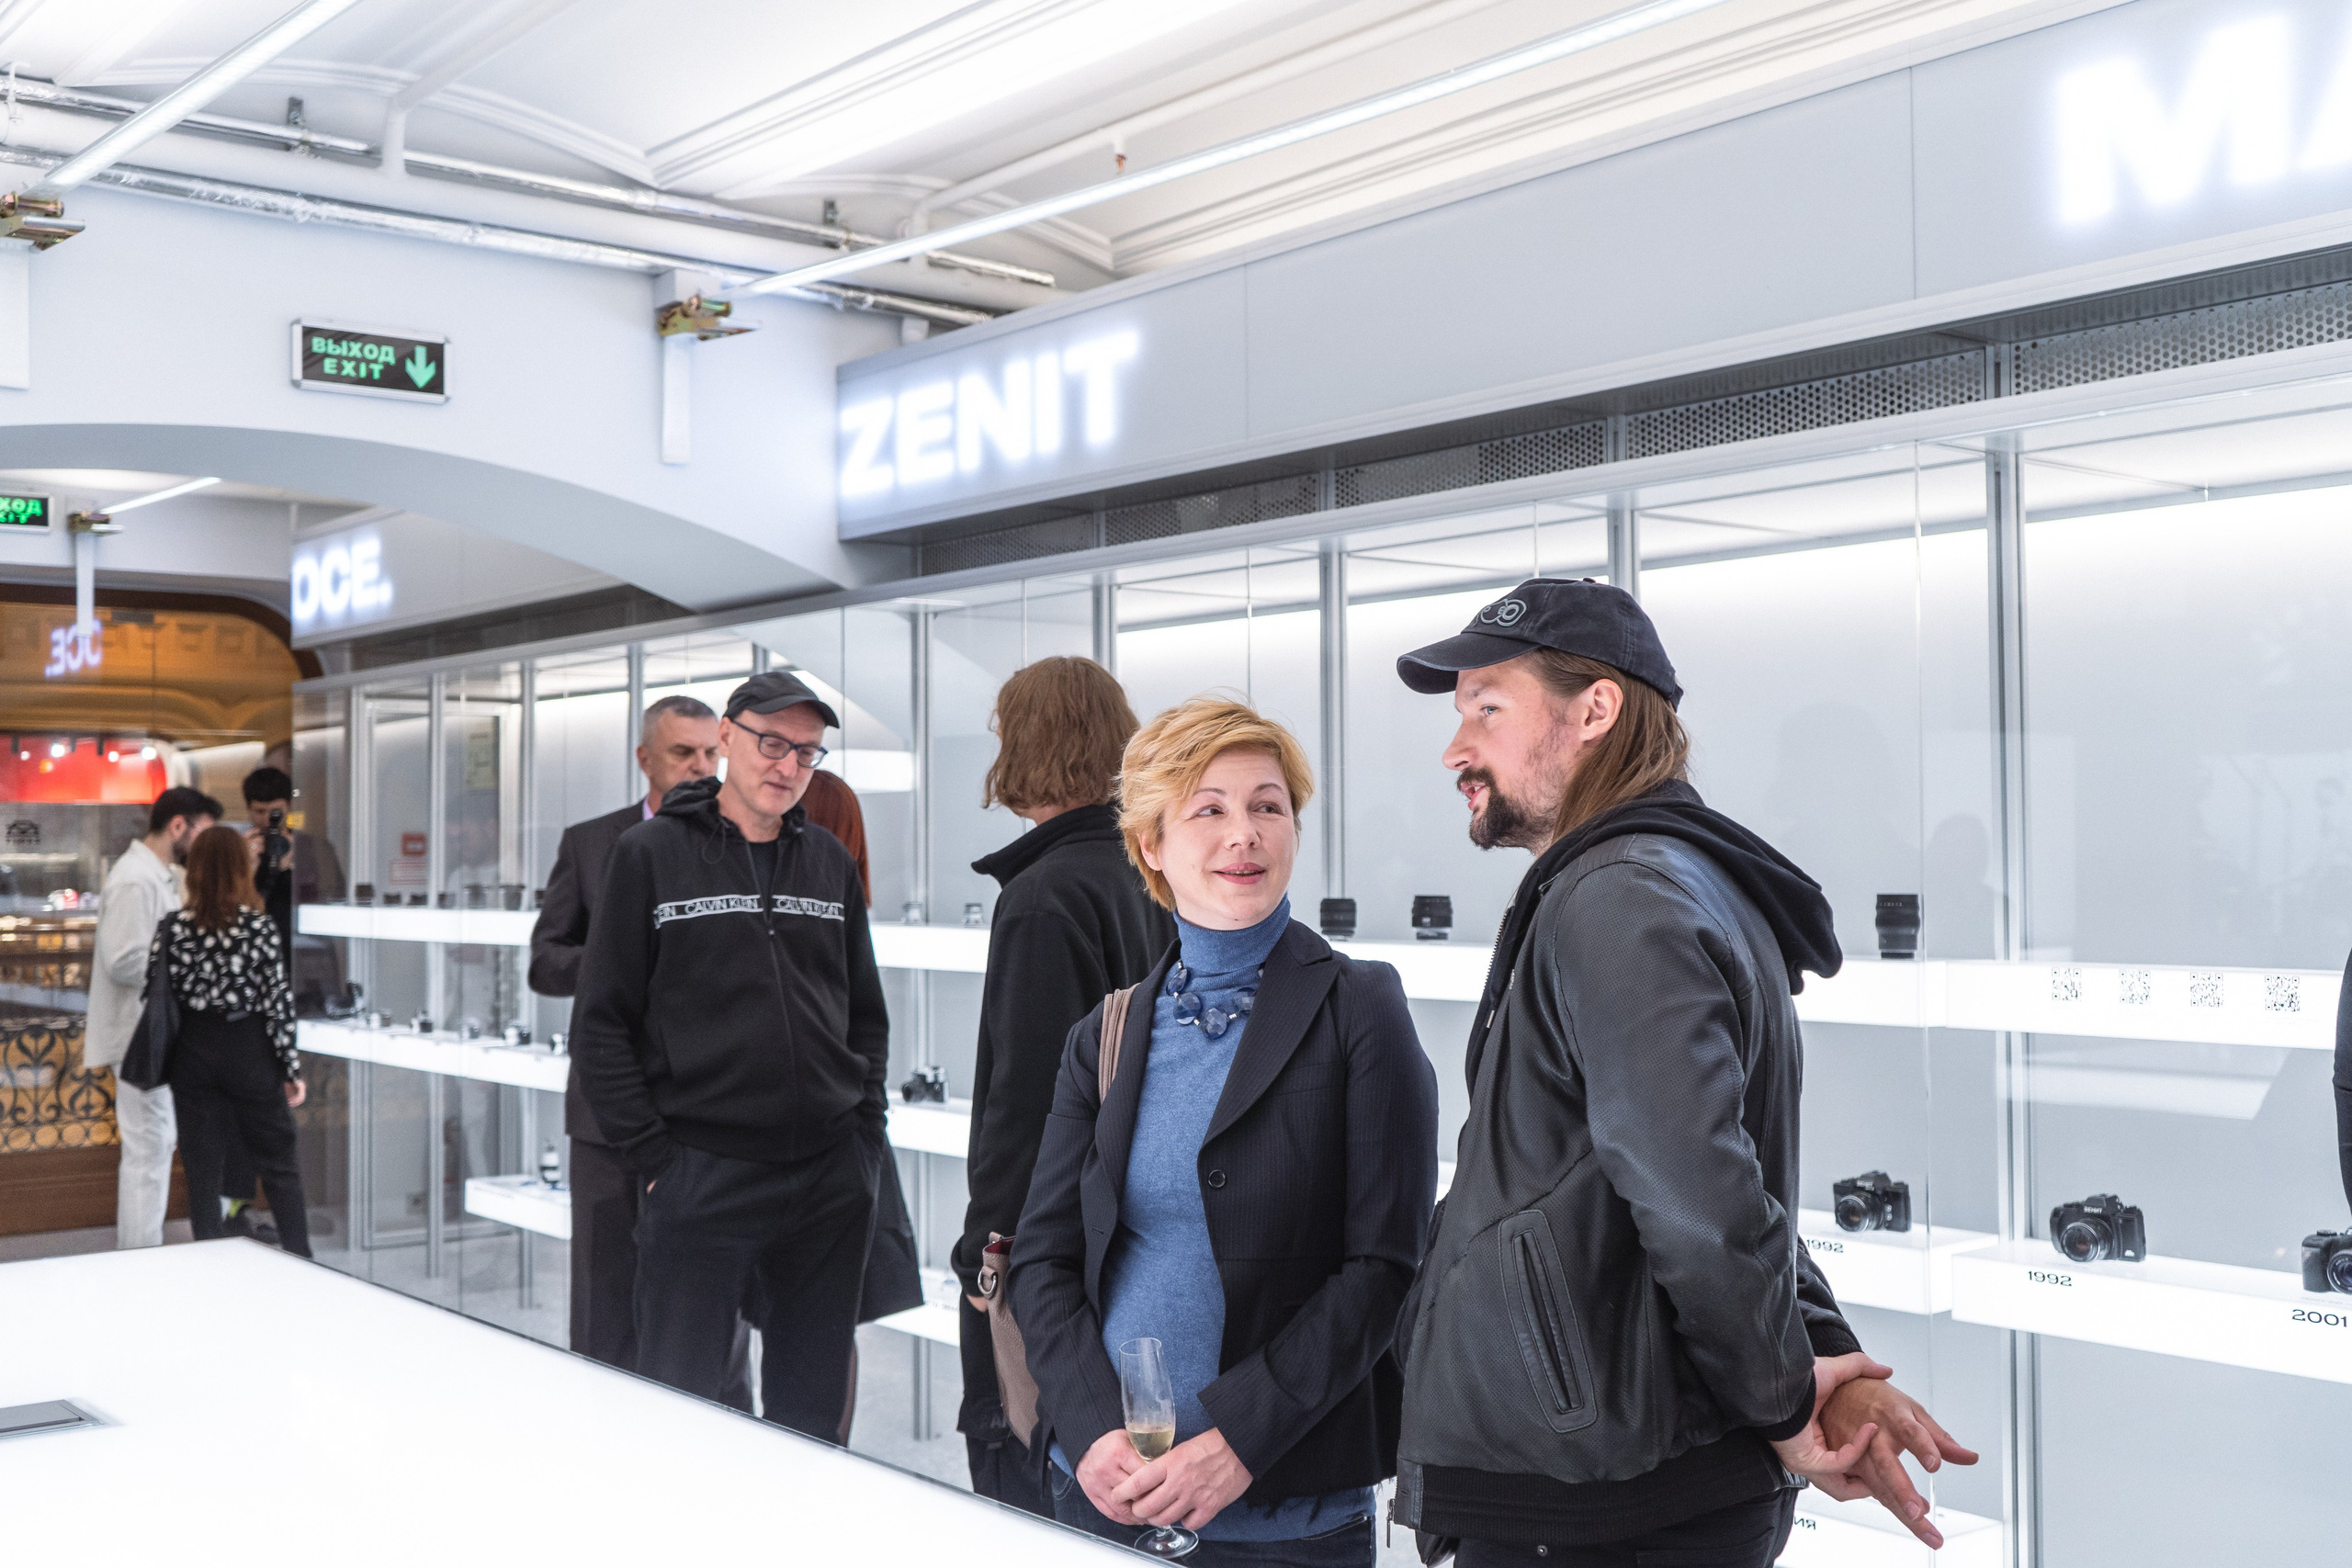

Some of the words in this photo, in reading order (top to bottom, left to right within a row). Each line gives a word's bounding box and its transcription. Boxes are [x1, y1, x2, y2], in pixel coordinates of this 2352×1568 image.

[2058, 11, 2352, 225] M
[311, 336, 396, 366] ВЫХОД
[322, 357, 384, 379] EXIT
[839, 328, 1140, 498] ZENIT
[0, 497, 43, 516] ХОД
[1805, 1238, 1844, 1253] 1992
[2028, 1270, 2073, 1287] 1992
[2291, 1308, 2347, 1328] 2001
